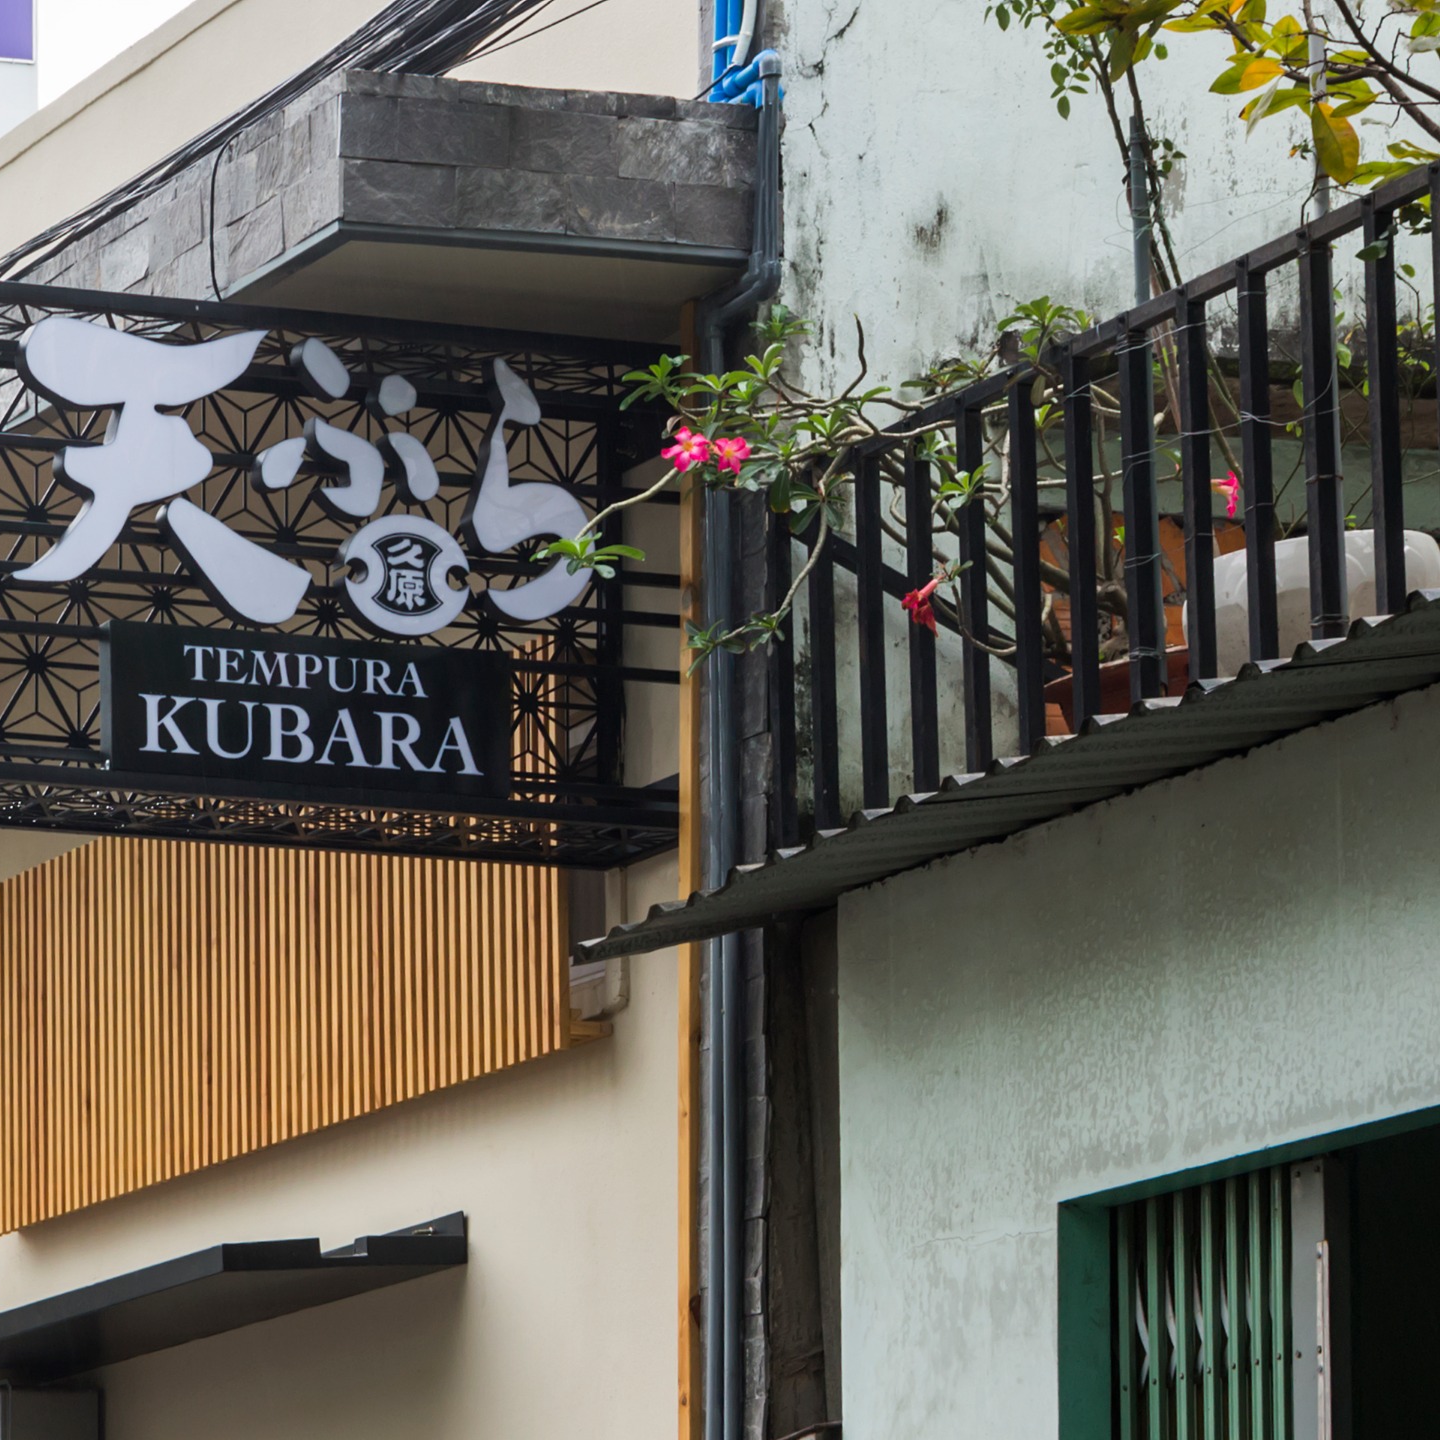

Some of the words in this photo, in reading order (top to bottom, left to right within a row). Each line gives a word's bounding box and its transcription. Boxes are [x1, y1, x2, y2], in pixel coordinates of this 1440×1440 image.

[12, 316, 594, 635] 天ぷら
[386, 538, 426, 611] 久原
[182, 643, 429, 699] TEMPURA
[138, 692, 484, 776] KUBARA
